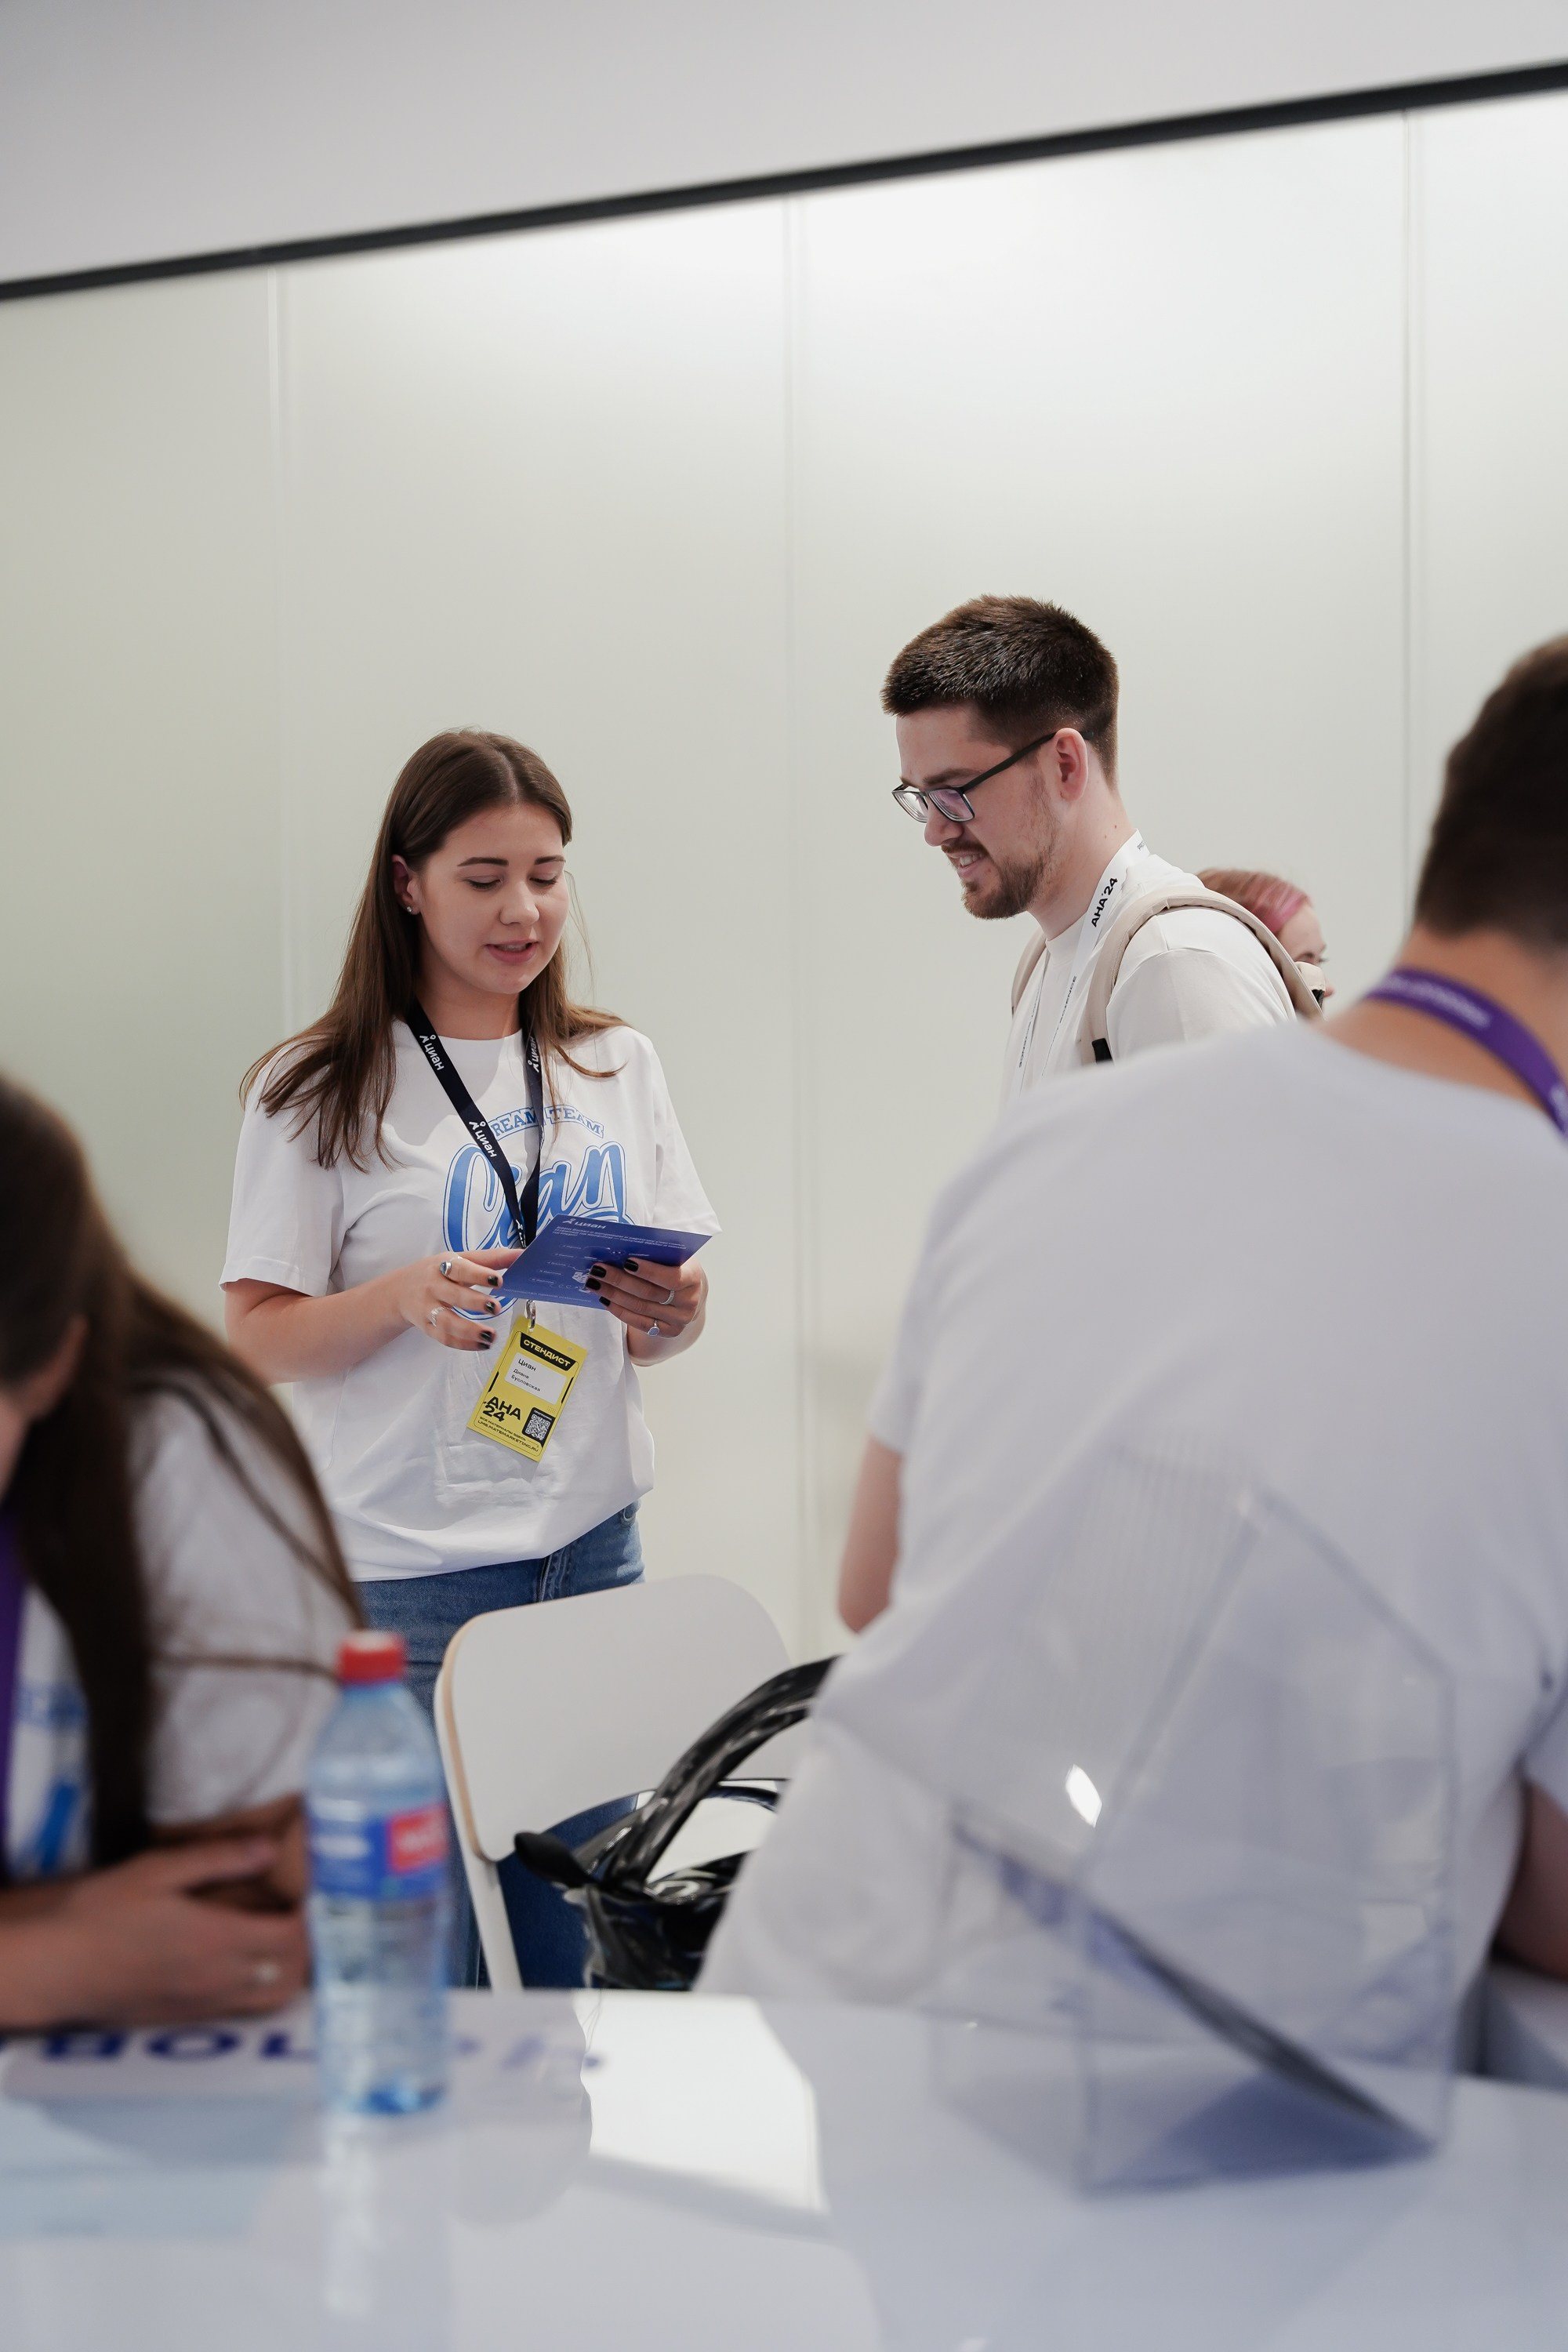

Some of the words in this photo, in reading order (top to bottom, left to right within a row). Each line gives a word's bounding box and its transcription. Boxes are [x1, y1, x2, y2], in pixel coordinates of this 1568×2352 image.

[424, 1043, 445, 1071] циан
[490, 1110, 546, 1137] REAM
[548, 1108, 601, 1134] TEAM
[475, 1130, 497, 1158] циан
[518, 1358, 536, 1372] Циан
[523, 1339, 571, 1367] СТЕНДИСТ
[513, 1368, 529, 1380] Диана
